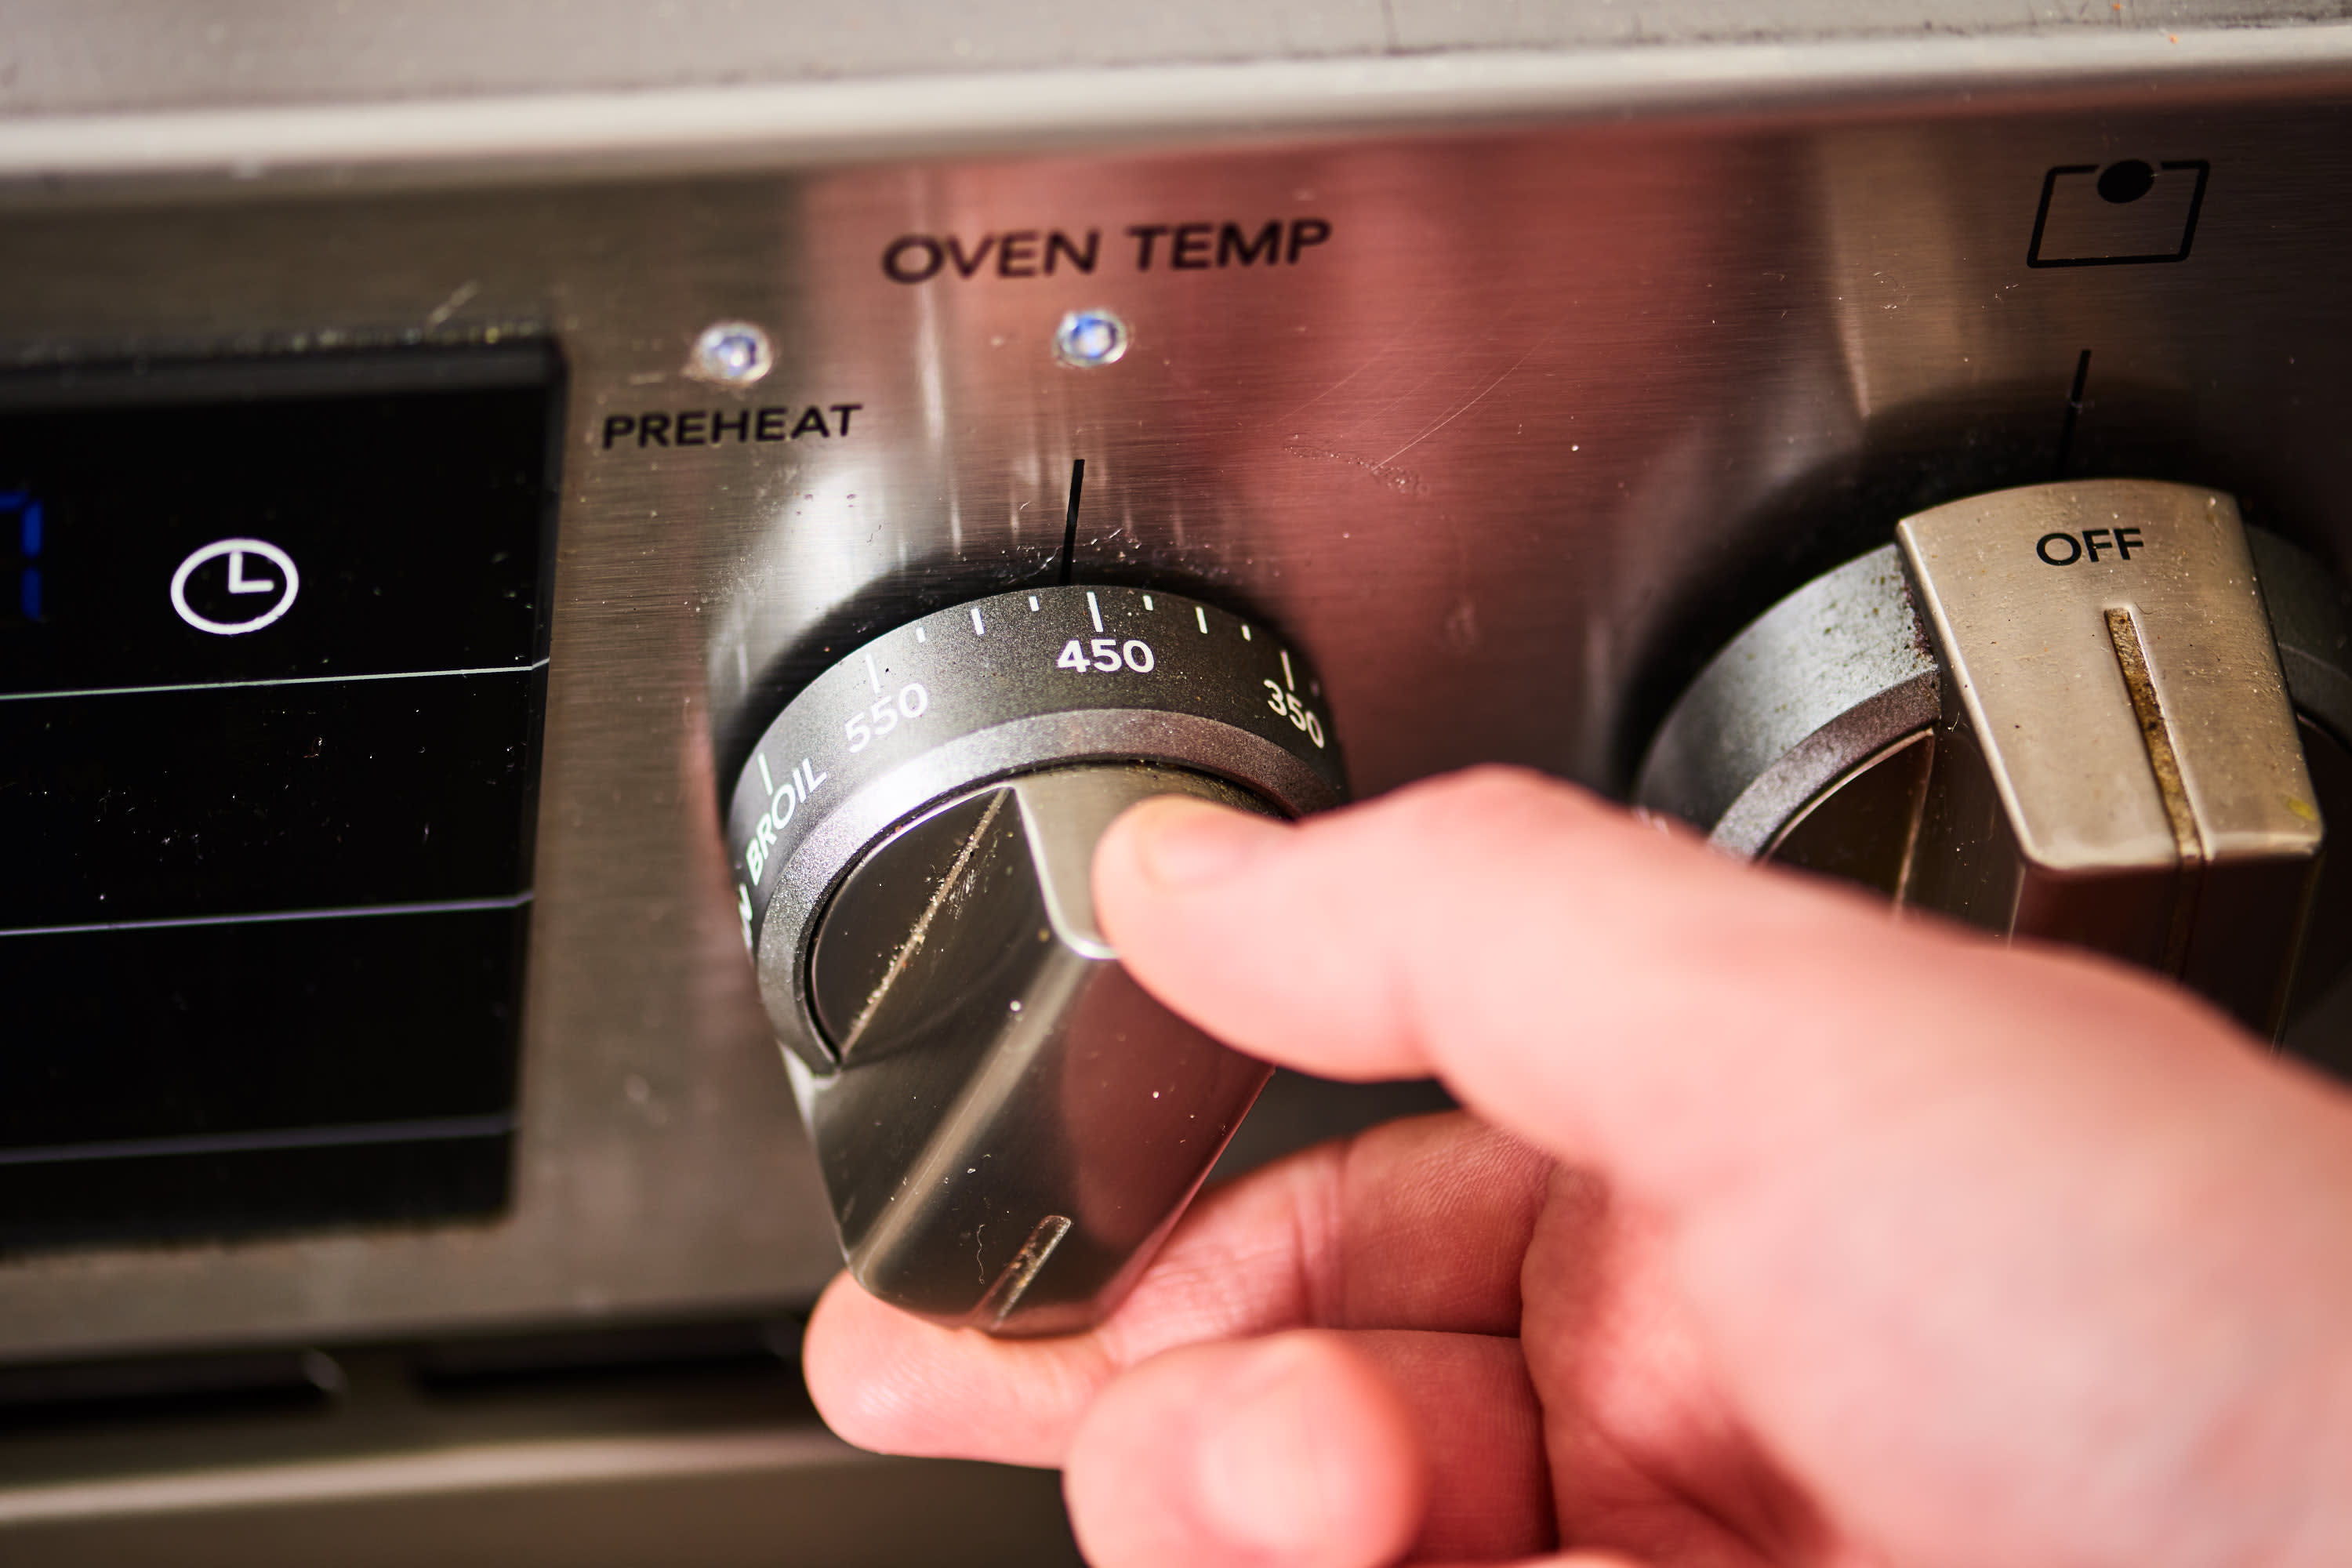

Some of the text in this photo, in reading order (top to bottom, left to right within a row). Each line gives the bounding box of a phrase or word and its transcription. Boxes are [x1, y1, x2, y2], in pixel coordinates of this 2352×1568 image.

[883, 219, 1331, 284] OVEN TEMP
[603, 404, 863, 449] PREHEAT
[2036, 528, 2144, 566] OFF
[1057, 639, 1155, 673] 450
[844, 683, 928, 753] 550
[1263, 679, 1326, 749] 350
[746, 758, 828, 886] BROIL
